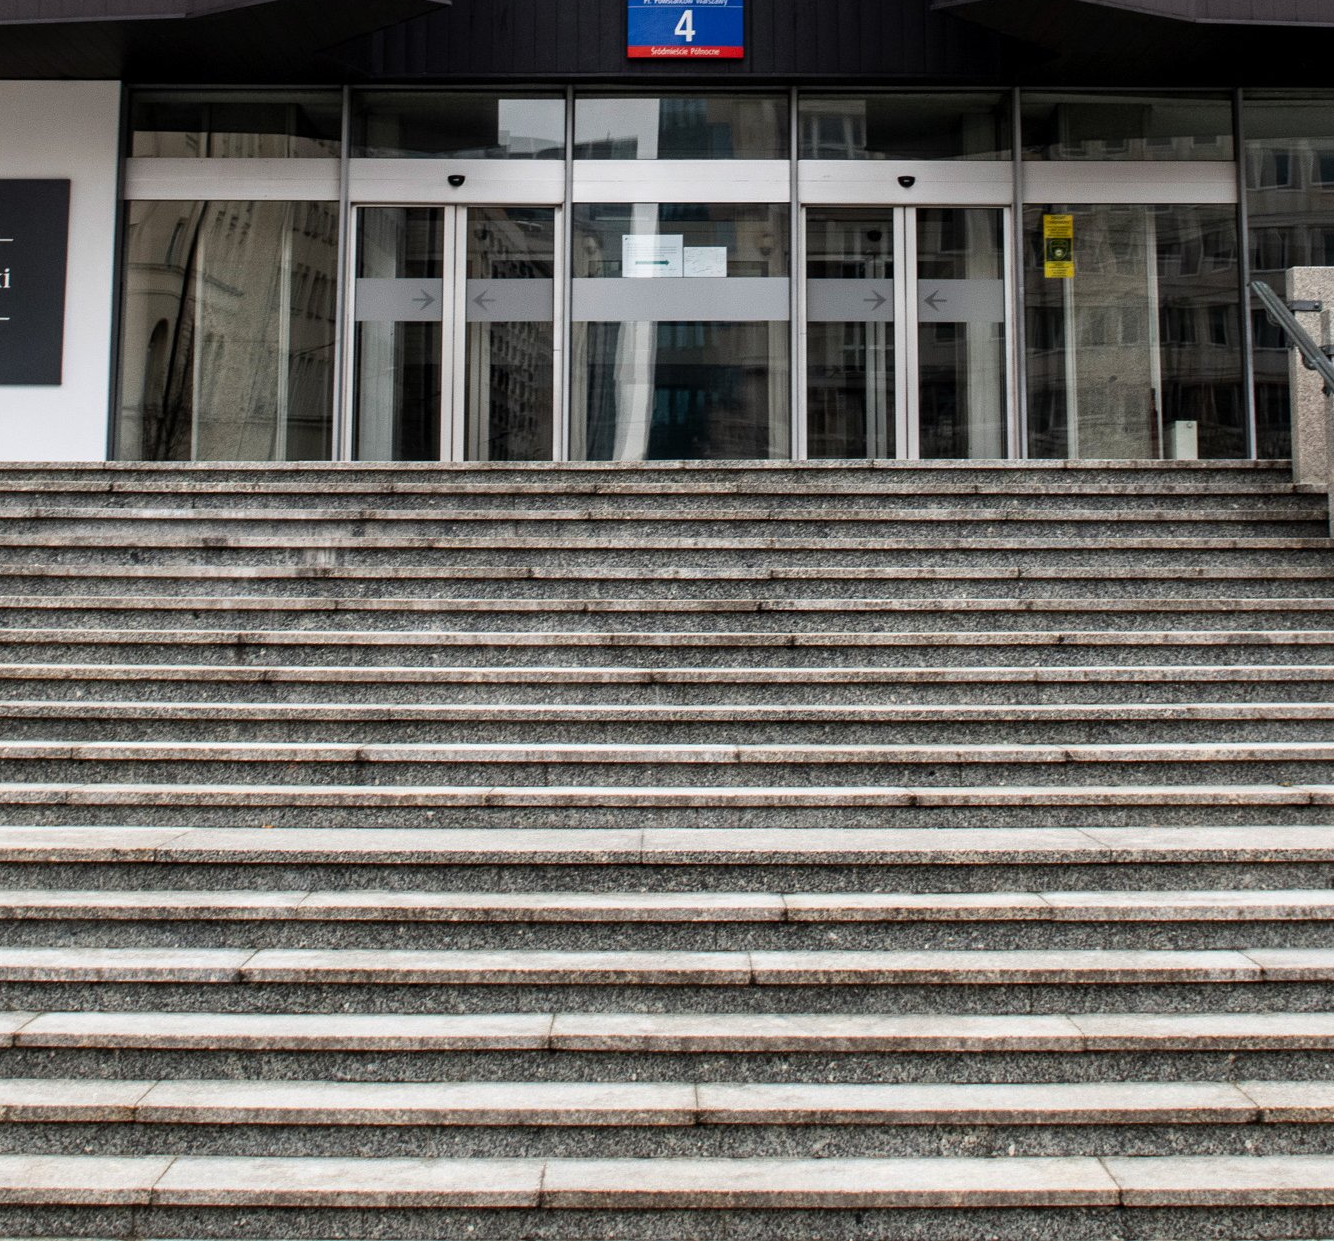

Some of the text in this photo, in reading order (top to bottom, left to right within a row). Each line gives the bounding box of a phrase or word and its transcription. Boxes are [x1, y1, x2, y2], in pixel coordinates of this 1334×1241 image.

[674, 9, 696, 42] 4
[650, 46, 720, 56] Śródmieście Północne
